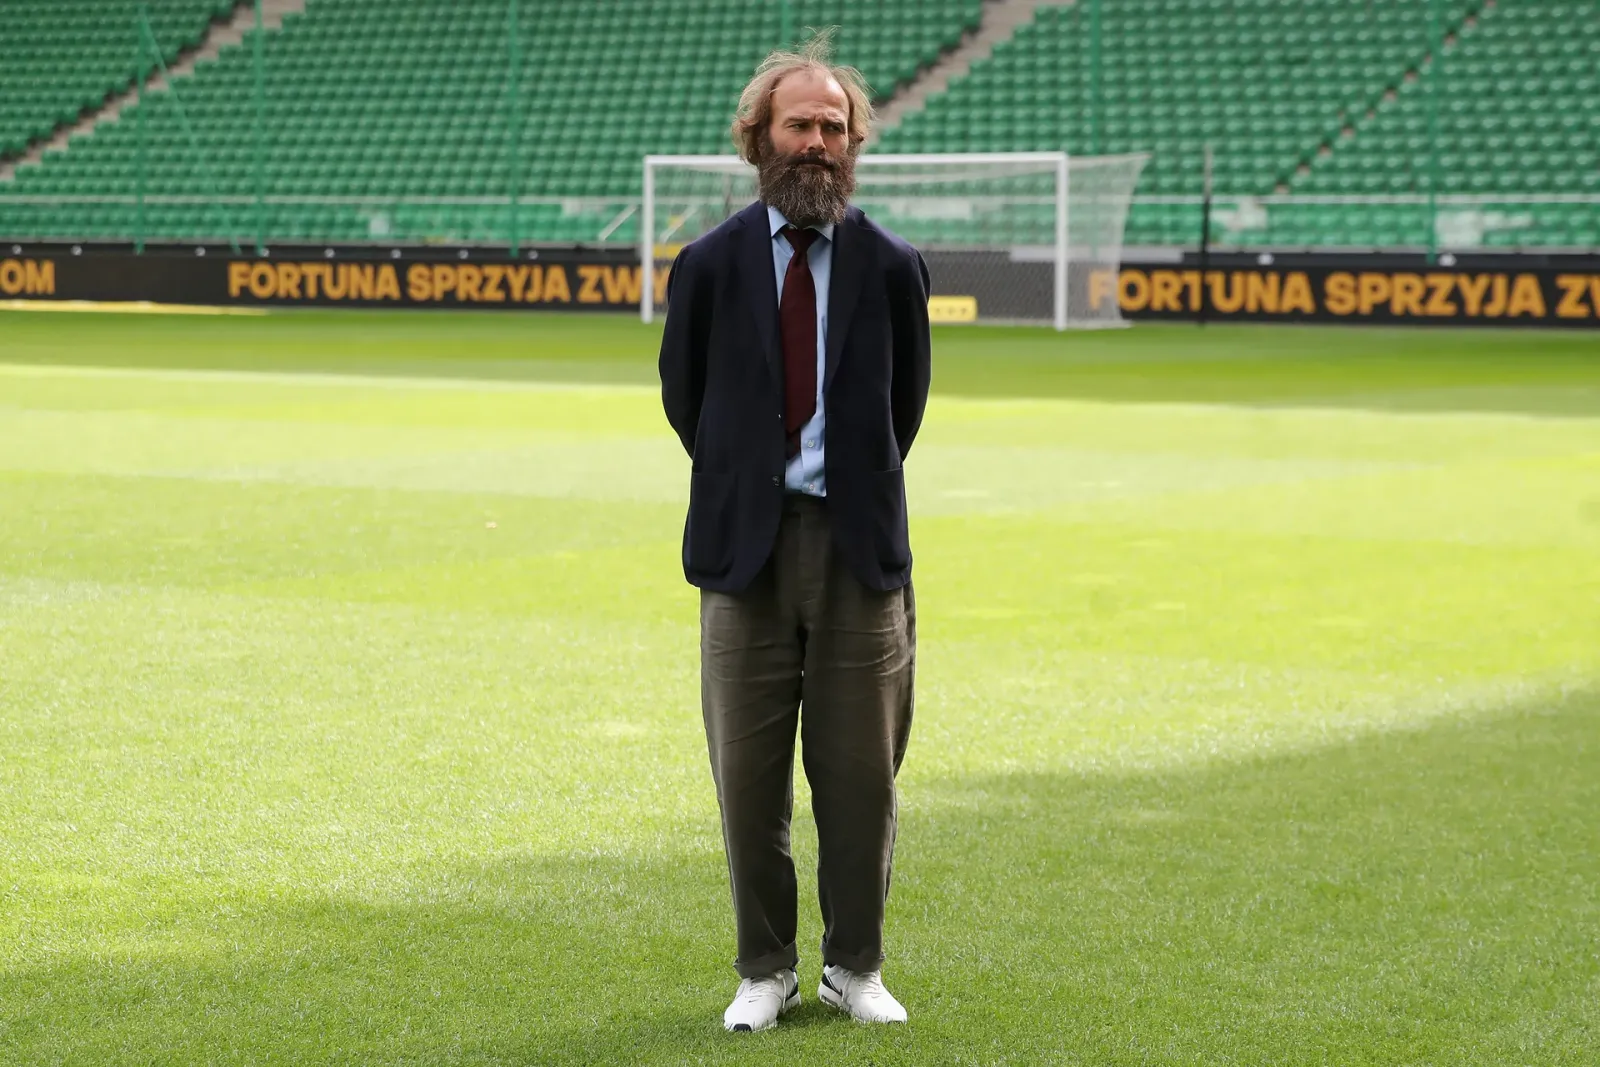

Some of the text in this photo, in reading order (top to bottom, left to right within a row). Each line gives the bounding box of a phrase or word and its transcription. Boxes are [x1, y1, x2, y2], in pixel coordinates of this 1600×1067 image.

[228, 261, 401, 299] FORTUNA
[407, 263, 570, 301] SPRZYJA
[1088, 268, 1600, 319] FORTUNA SPRZYJA Z
